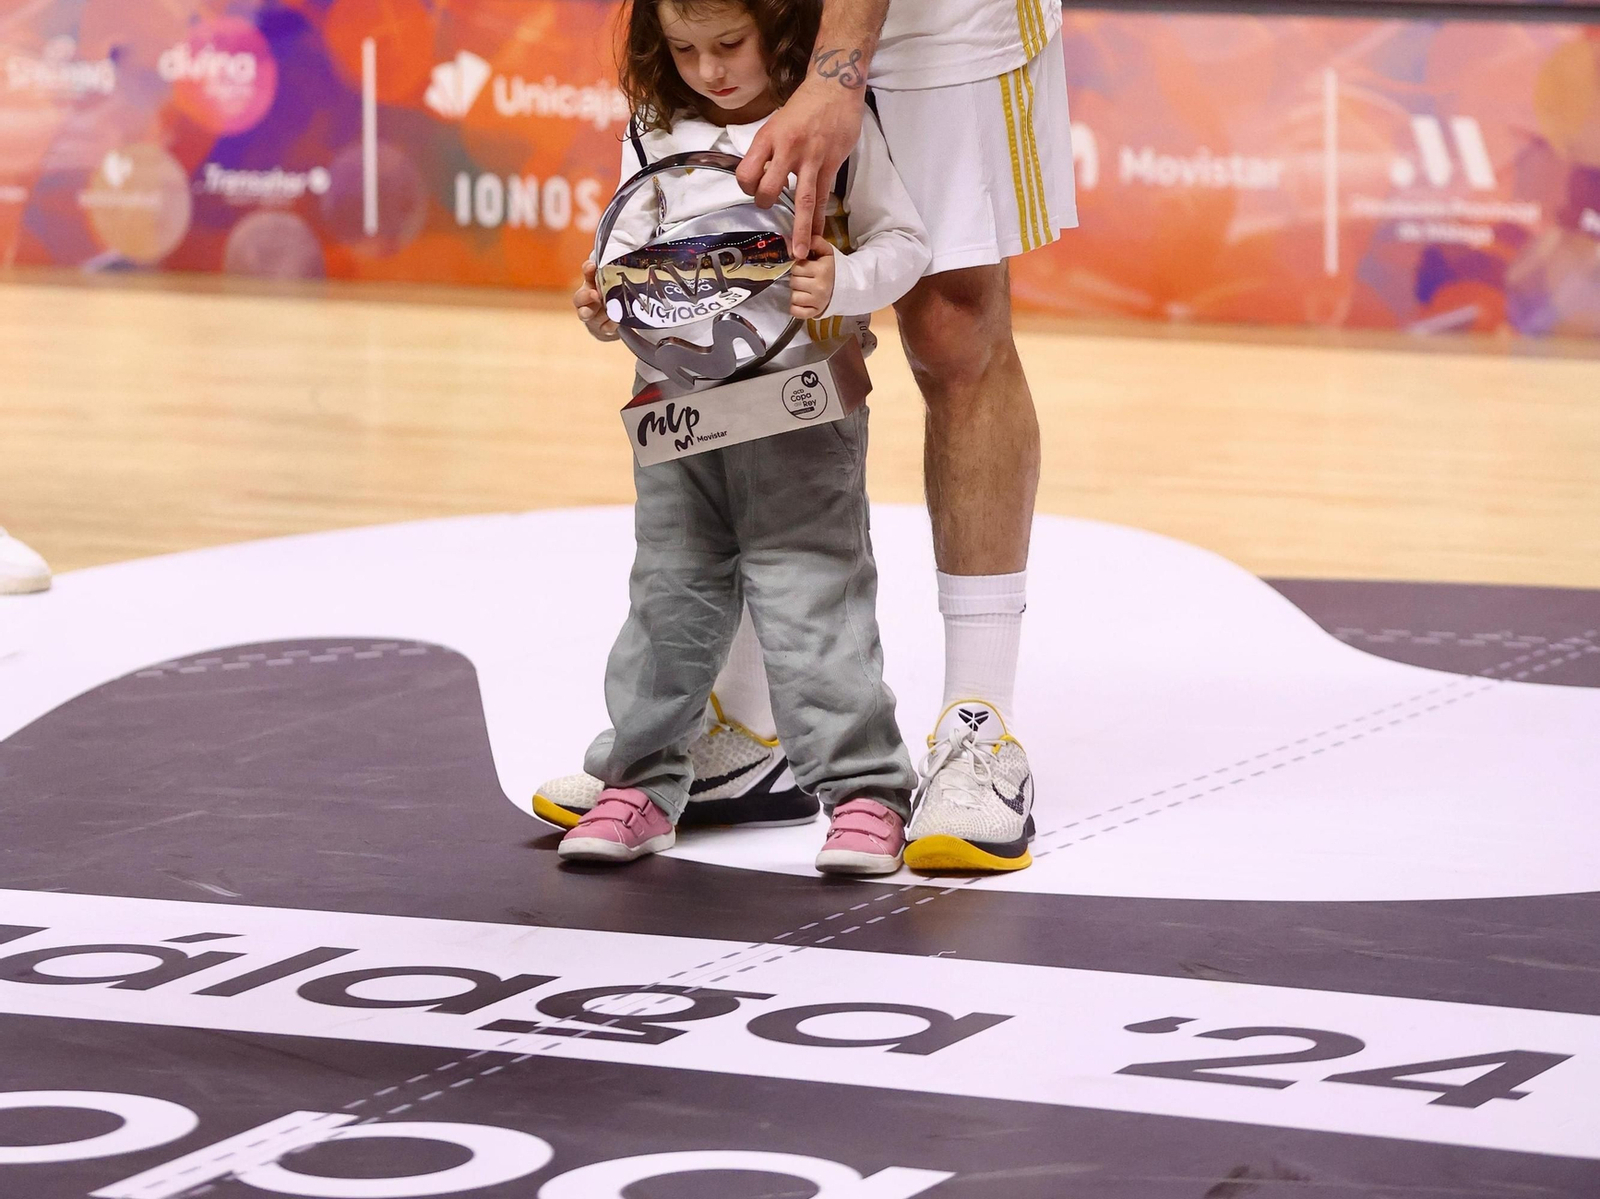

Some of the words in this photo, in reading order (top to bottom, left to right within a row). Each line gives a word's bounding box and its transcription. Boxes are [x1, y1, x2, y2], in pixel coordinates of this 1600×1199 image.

[1118, 146, 1281, 188] Movistar
[454, 171, 602, 232] IONOS
[790, 392, 812, 402] Copa
[696, 430, 728, 443] Movistar
